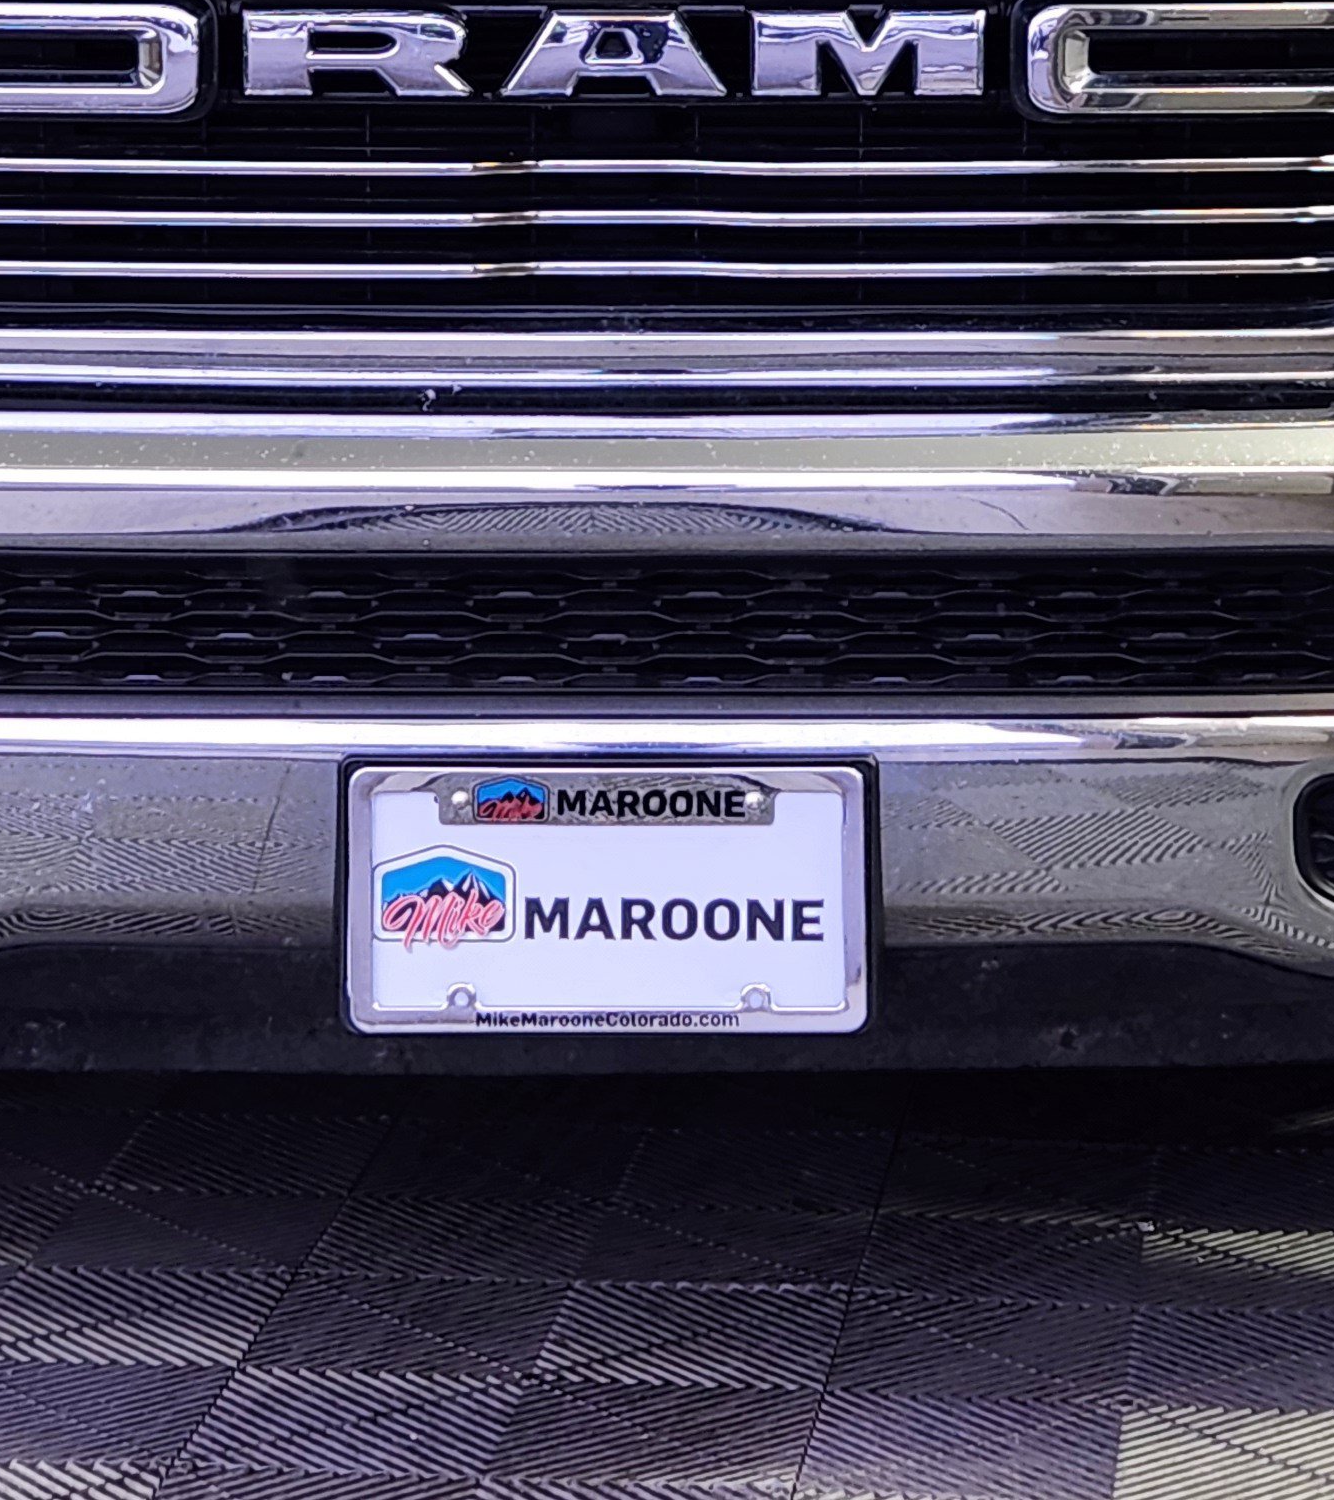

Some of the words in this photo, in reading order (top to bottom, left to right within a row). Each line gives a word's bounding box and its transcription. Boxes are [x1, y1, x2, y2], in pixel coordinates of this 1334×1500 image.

[242, 9, 988, 97] RAM
[556, 789, 746, 818] MAROONE
[382, 888, 505, 953] Mike
[524, 896, 825, 942] MAROONE
[475, 1011, 740, 1028] MikeMarooneColorado.com
